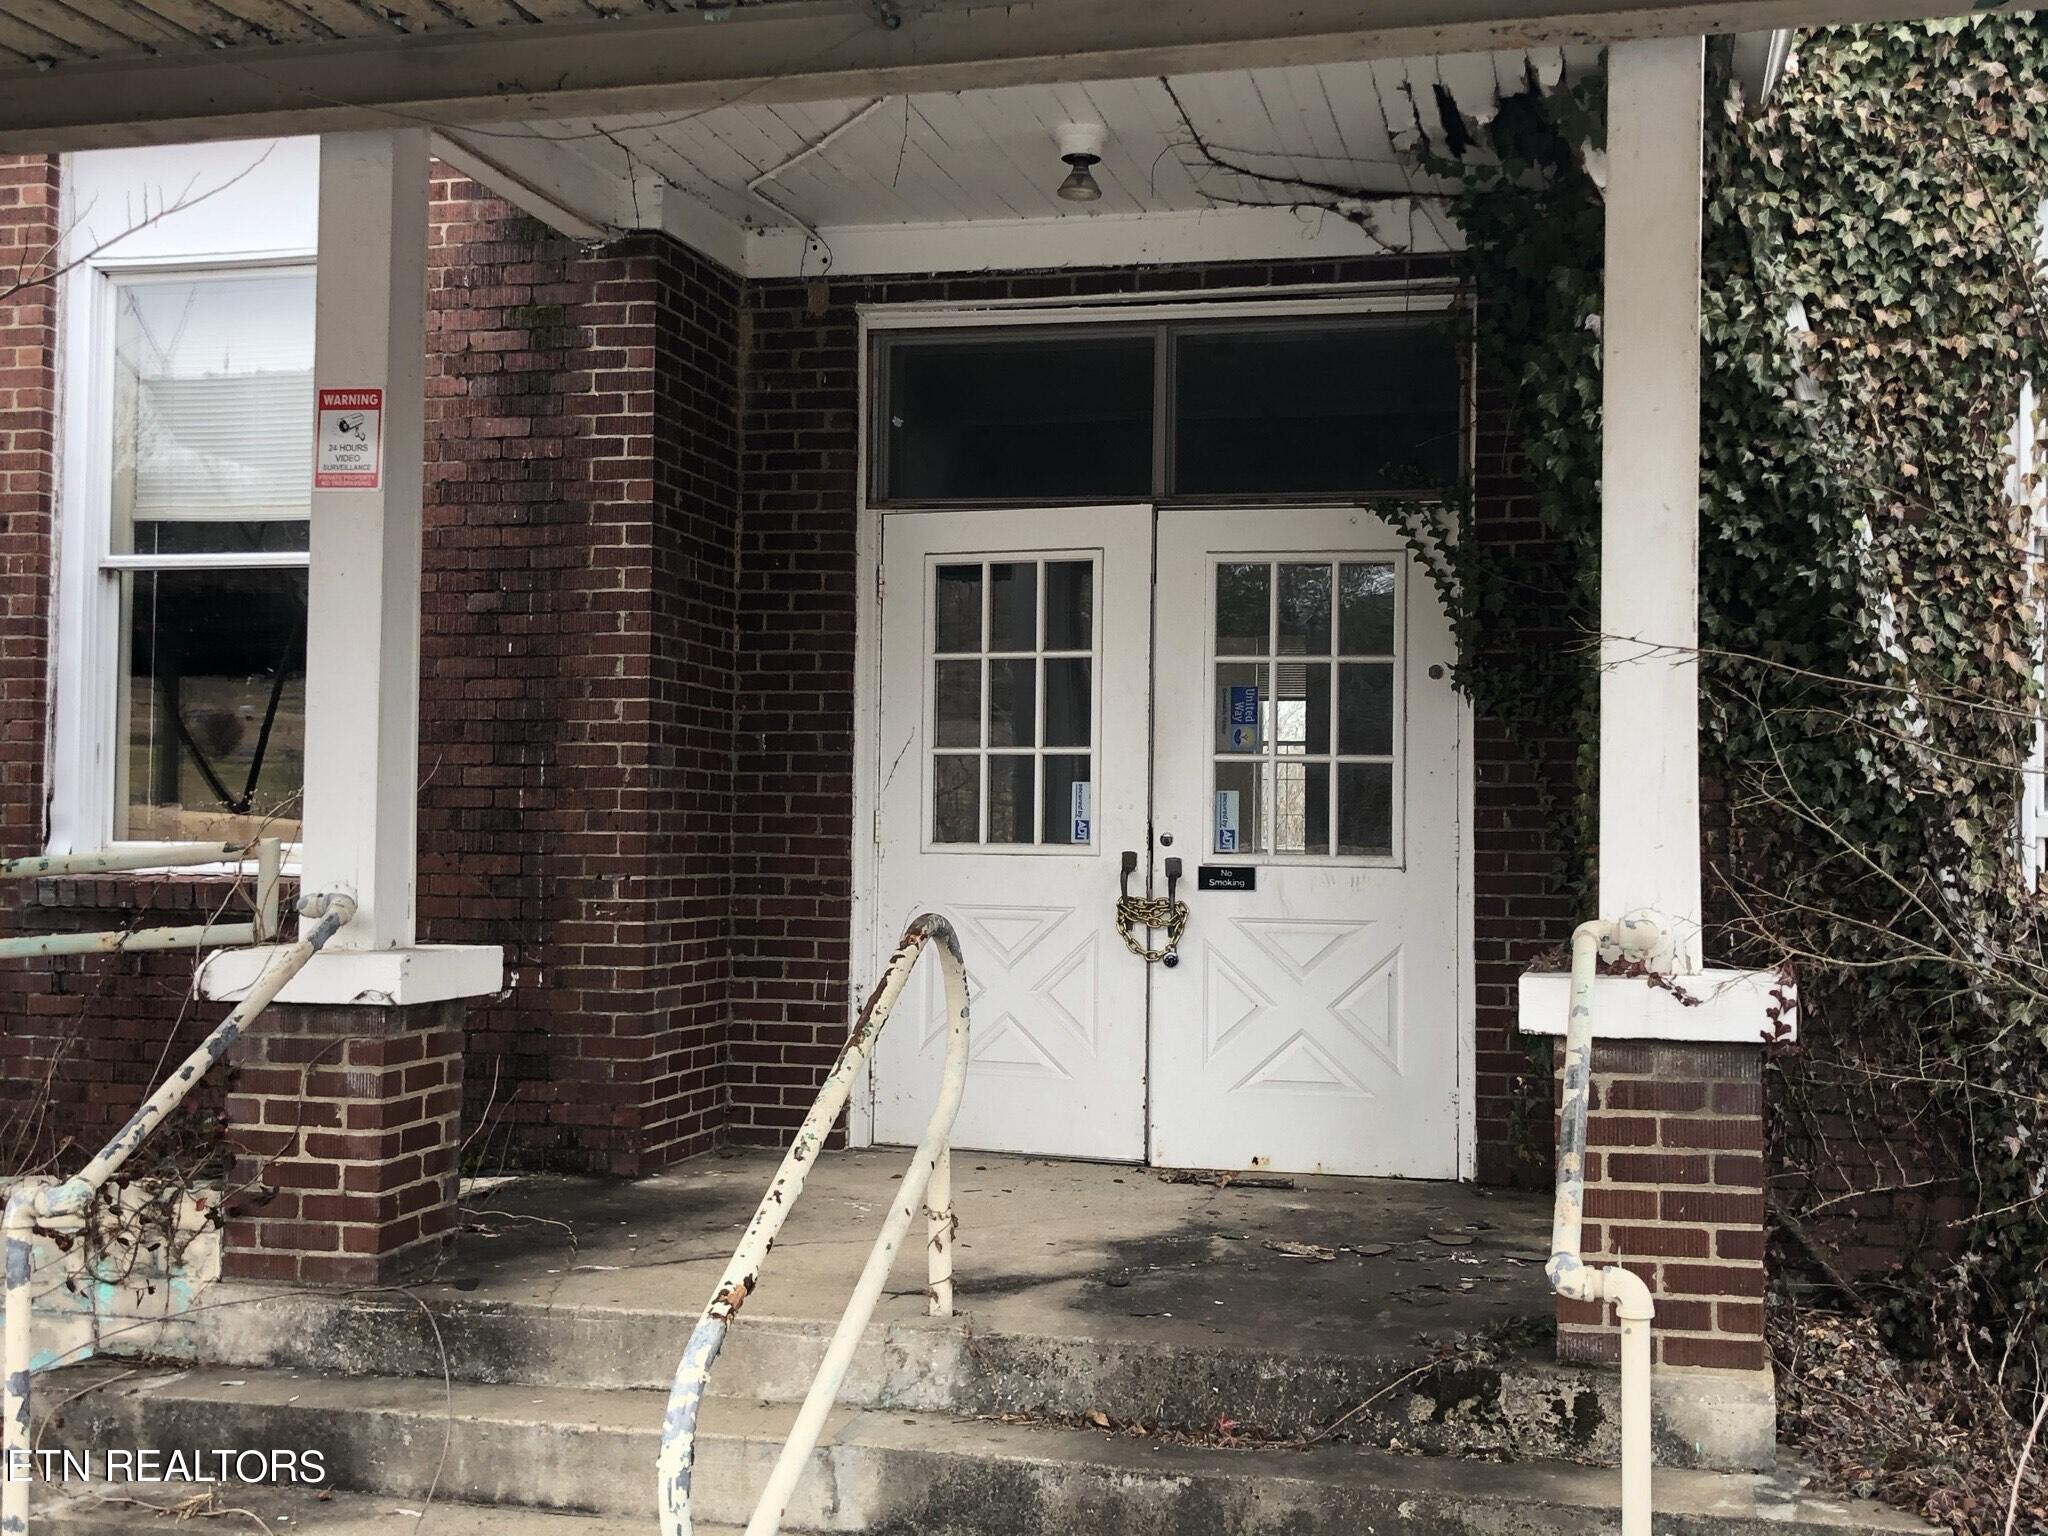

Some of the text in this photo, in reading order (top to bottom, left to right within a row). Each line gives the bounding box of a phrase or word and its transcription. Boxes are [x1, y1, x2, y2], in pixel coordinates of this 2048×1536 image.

[323, 394, 379, 406] WARNING
[328, 443, 369, 452] 24 HOURS
[335, 454, 361, 462] VIDEO
[1245, 688, 1256, 722] United
[1231, 701, 1245, 722] Way
[1077, 820, 1088, 838] ADT
[1222, 829, 1233, 849] ADT
[1220, 869, 1233, 877] No
[1208, 878, 1246, 888] Smoking
